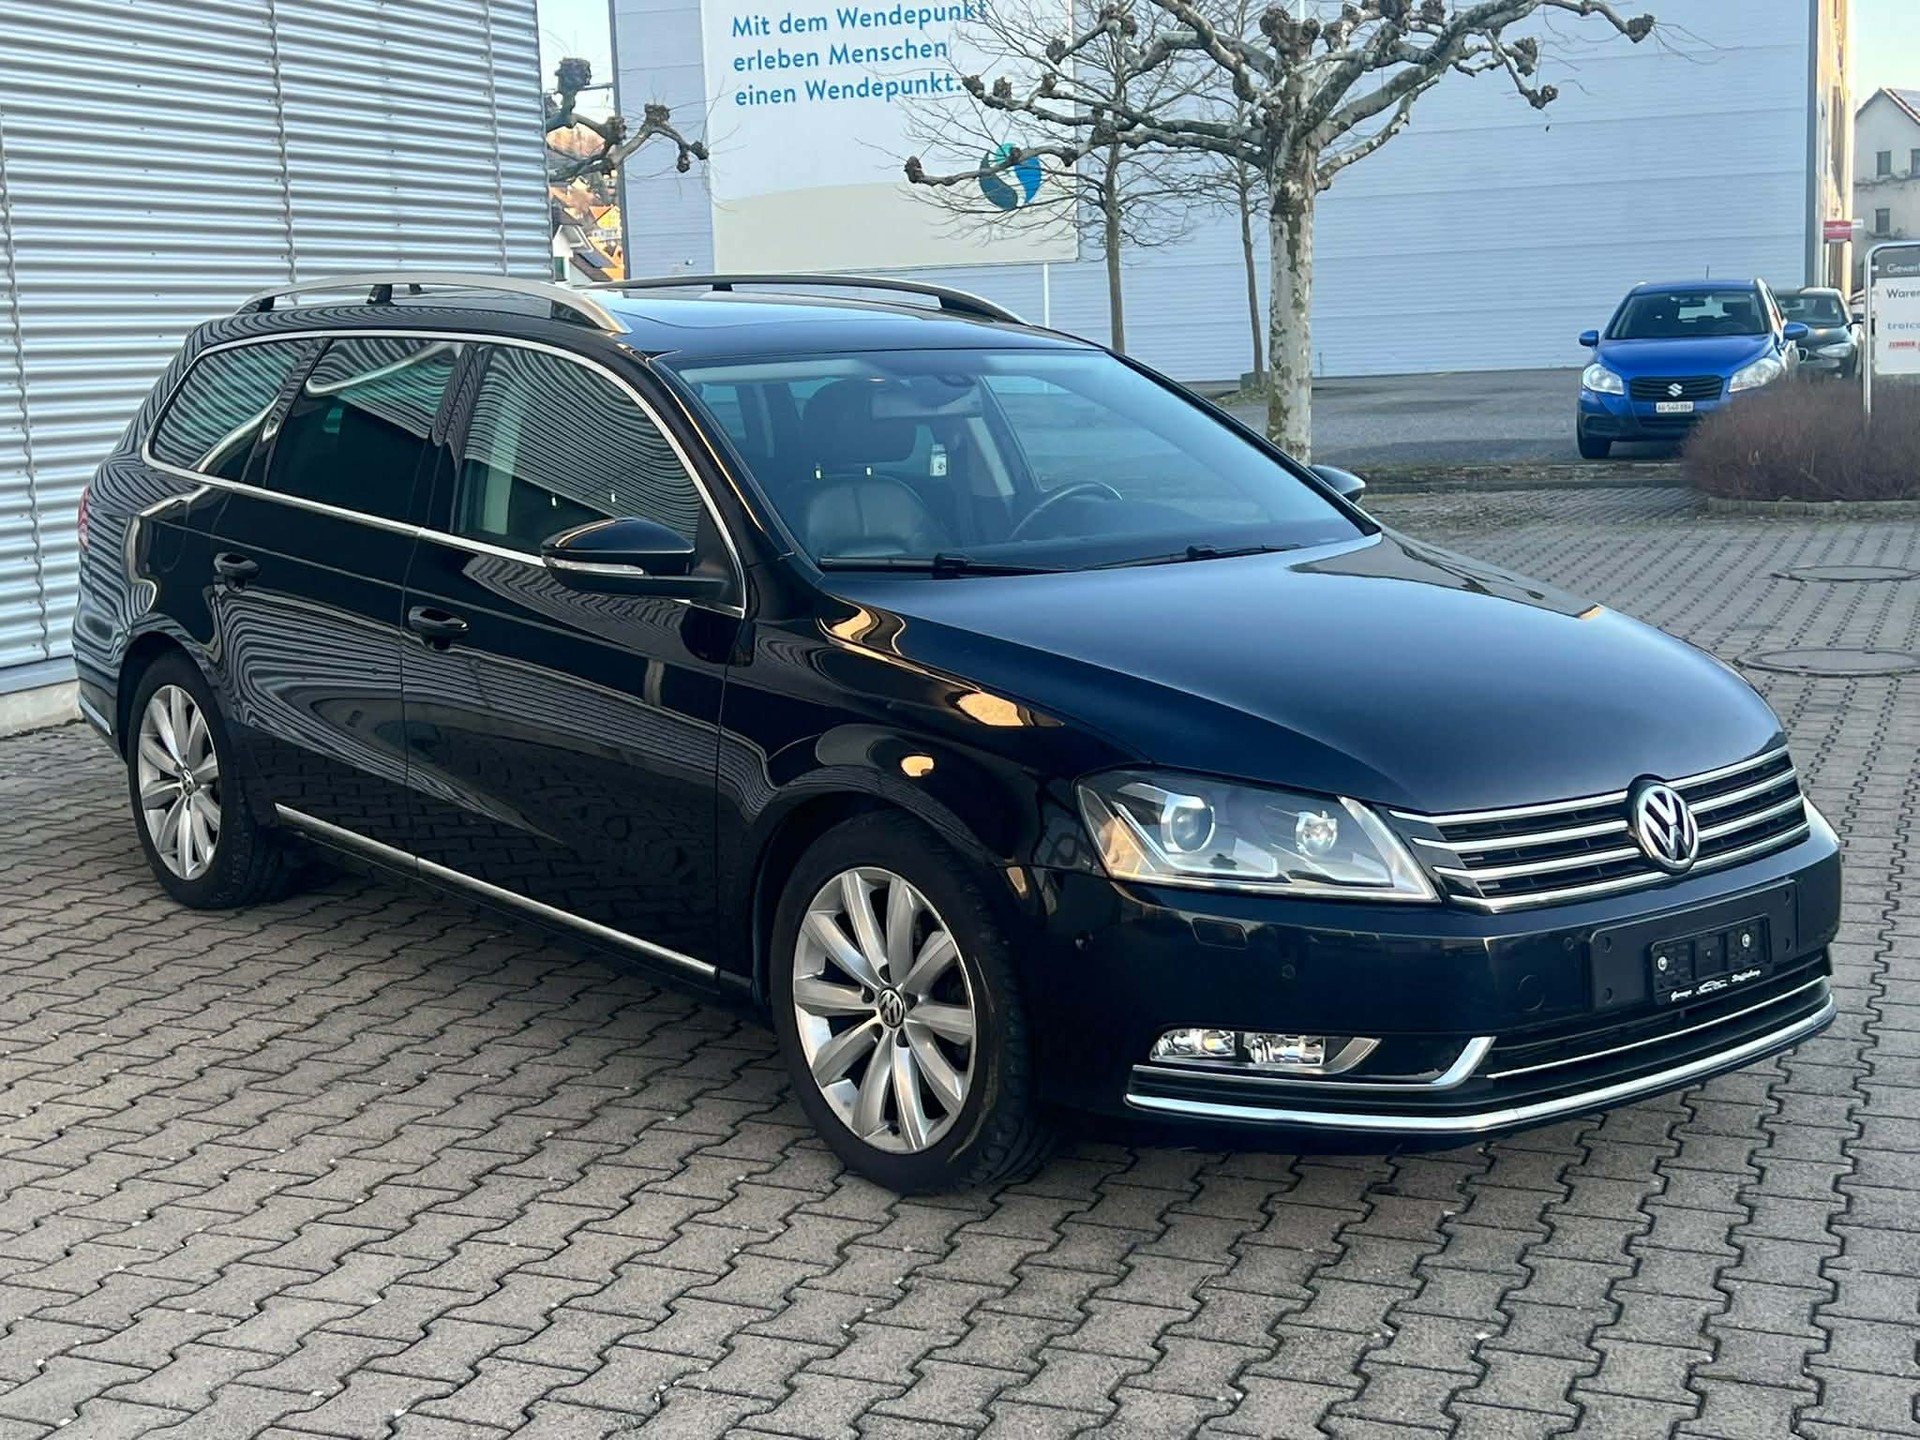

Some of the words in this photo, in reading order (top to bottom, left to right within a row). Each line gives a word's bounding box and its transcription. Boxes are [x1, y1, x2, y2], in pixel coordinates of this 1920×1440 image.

[732, 15, 770, 37] Mit
[779, 12, 828, 34] dem
[734, 49, 819, 71] erleben
[829, 38, 948, 65] Menschen
[735, 85, 796, 106] einen
[805, 72, 963, 103] Wendepunkt.
